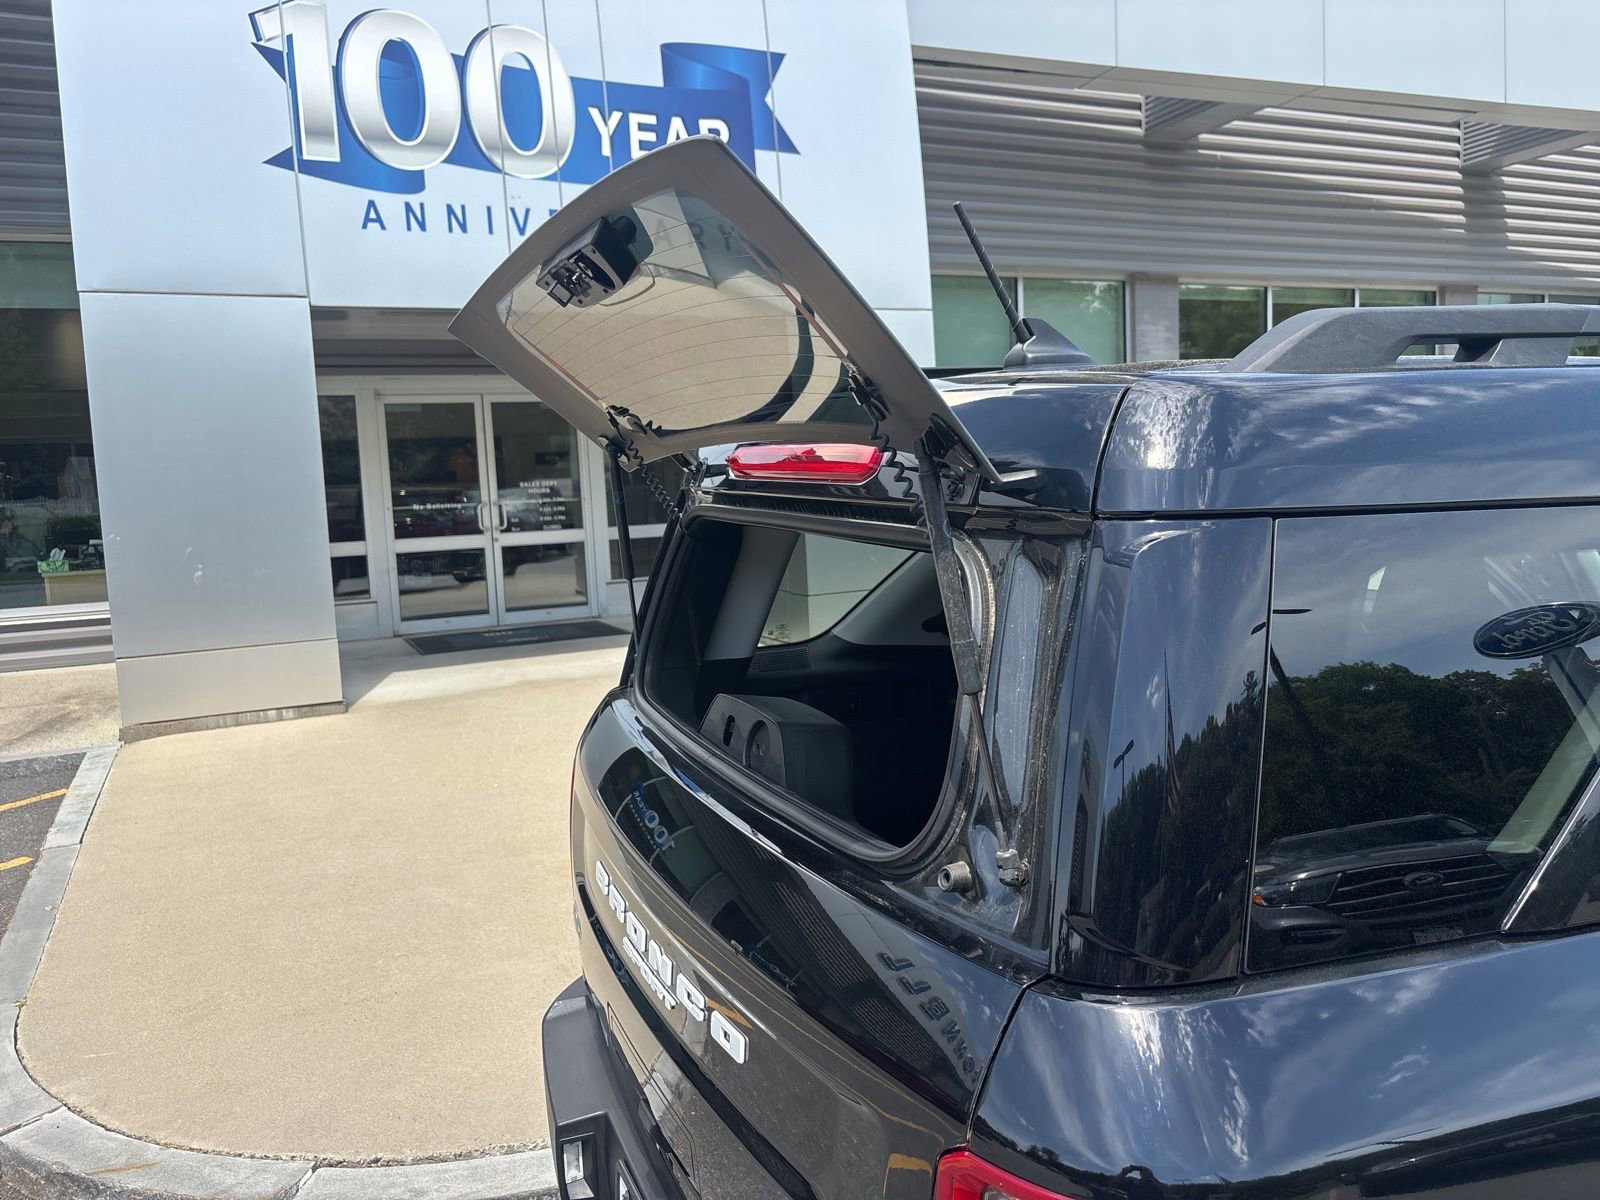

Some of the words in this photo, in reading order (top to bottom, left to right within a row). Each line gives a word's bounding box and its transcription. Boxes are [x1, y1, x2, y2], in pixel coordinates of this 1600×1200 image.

[248, 0, 576, 179] 100
[595, 860, 750, 1065] BRONCO
[622, 936, 680, 1010] SPORT
